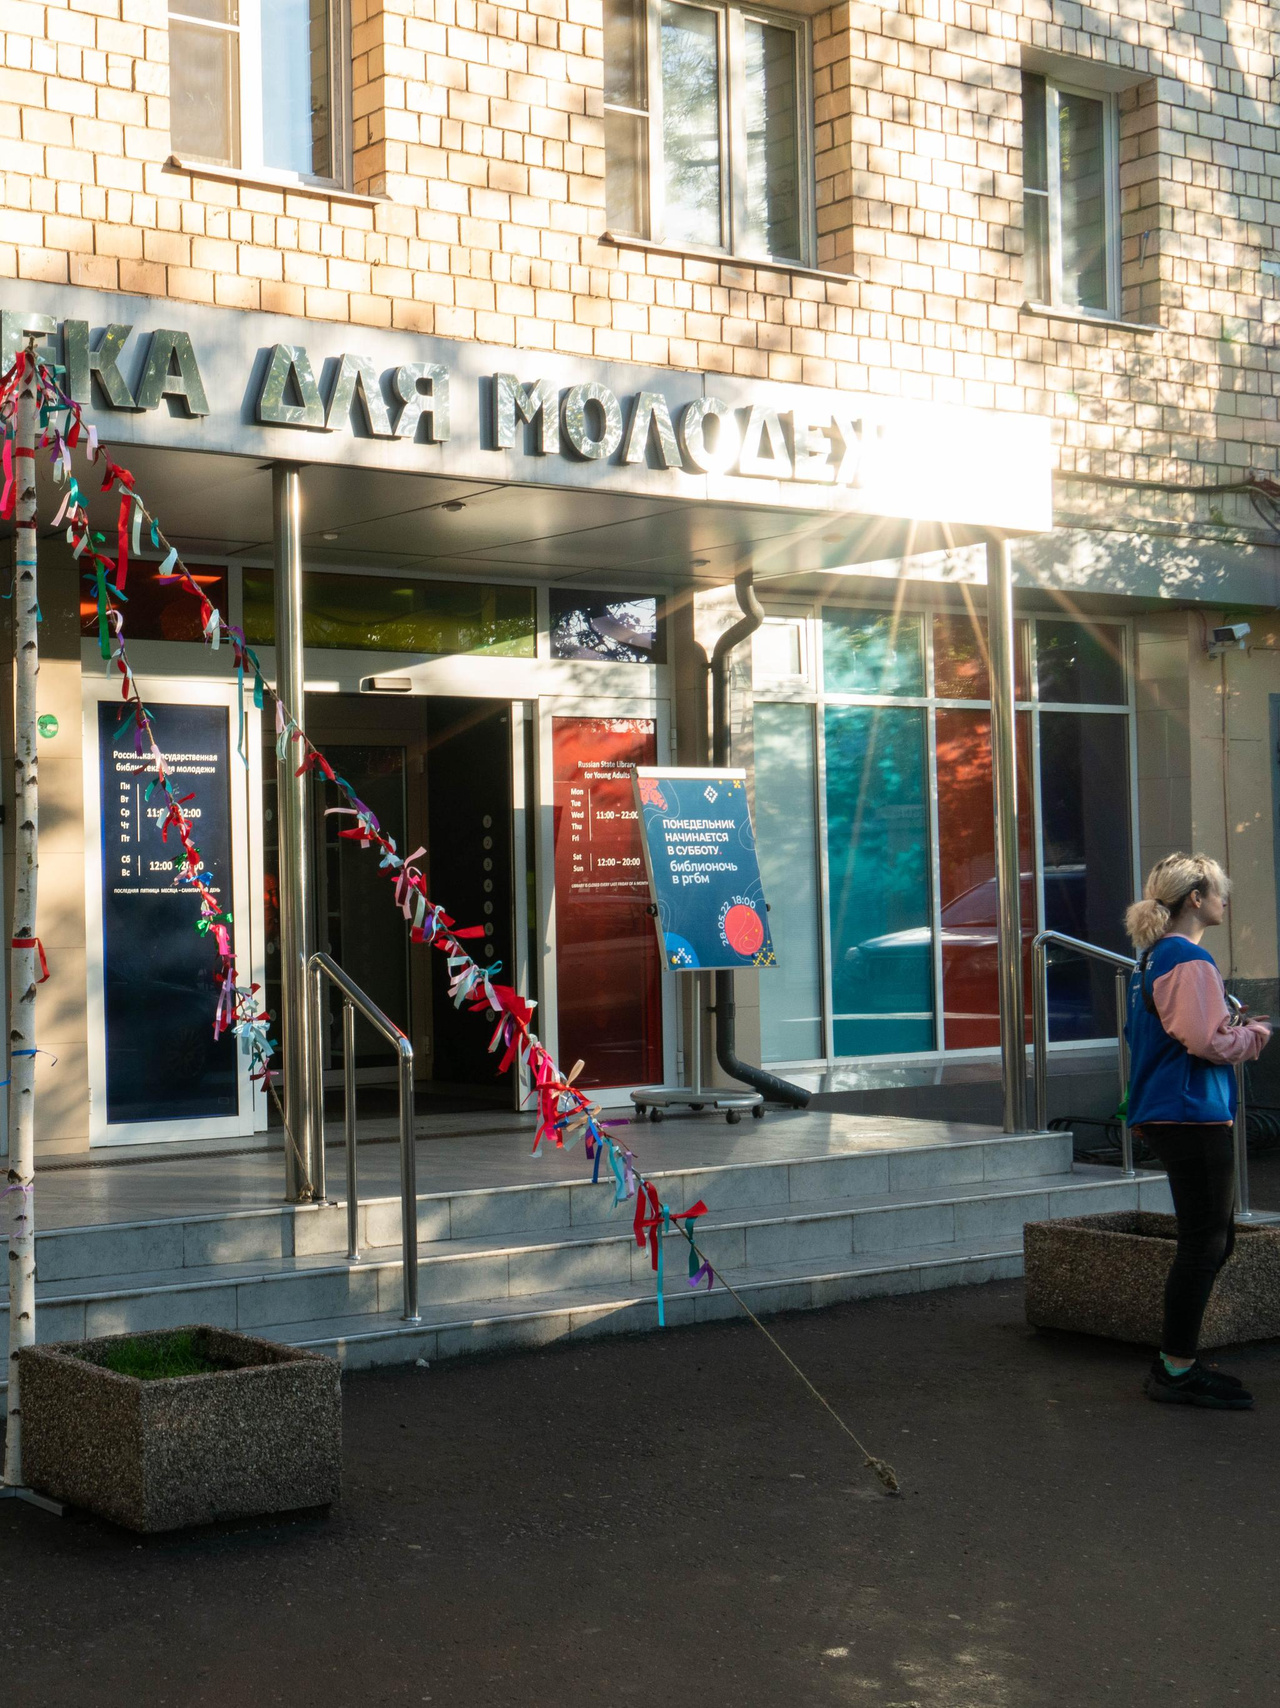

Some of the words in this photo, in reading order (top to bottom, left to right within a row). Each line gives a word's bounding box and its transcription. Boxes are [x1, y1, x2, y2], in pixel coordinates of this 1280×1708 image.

[257, 342, 451, 444] ДЛЯ
[492, 370, 892, 490] МОЛОДЕЖ
[113, 750, 155, 760] Россикая
[157, 753, 218, 763] осударственная
[115, 762, 160, 773] библиека
[176, 766, 216, 775] молодежи
[616, 761, 636, 769] Library
[584, 771, 593, 779] for
[593, 771, 612, 780] Young
[612, 771, 631, 779] Adults
[120, 782, 131, 790] Пн
[570, 788, 584, 796] Mon
[120, 795, 129, 803] Вт
[120, 808, 131, 818] Ср
[178, 808, 202, 818] 2:00
[571, 811, 584, 819] Wed
[596, 811, 615, 819] 11:00
[120, 821, 130, 829] Чт
[662, 819, 736, 831] ПОНЕДЕЛЬНИК
[121, 834, 131, 842] Пт
[571, 834, 580, 842] Fri
[665, 832, 729, 842] НАЧИНАЕТСЯ
[667, 845, 675, 855] В
[121, 855, 131, 863] Сб
[572, 853, 582, 861] Sat
[149, 861, 173, 871] 12:00
[181, 861, 204, 871] 2000
[597, 858, 616, 867] 12:00
[622, 857, 641, 866] 20:00
[669, 859, 738, 872] библионочь
[121, 868, 131, 876] Вс
[672, 875, 680, 884] в
[681, 872, 710, 887] ргбм
[717, 901, 731, 947] 28.05.22
[731, 895, 756, 909] 18:00
